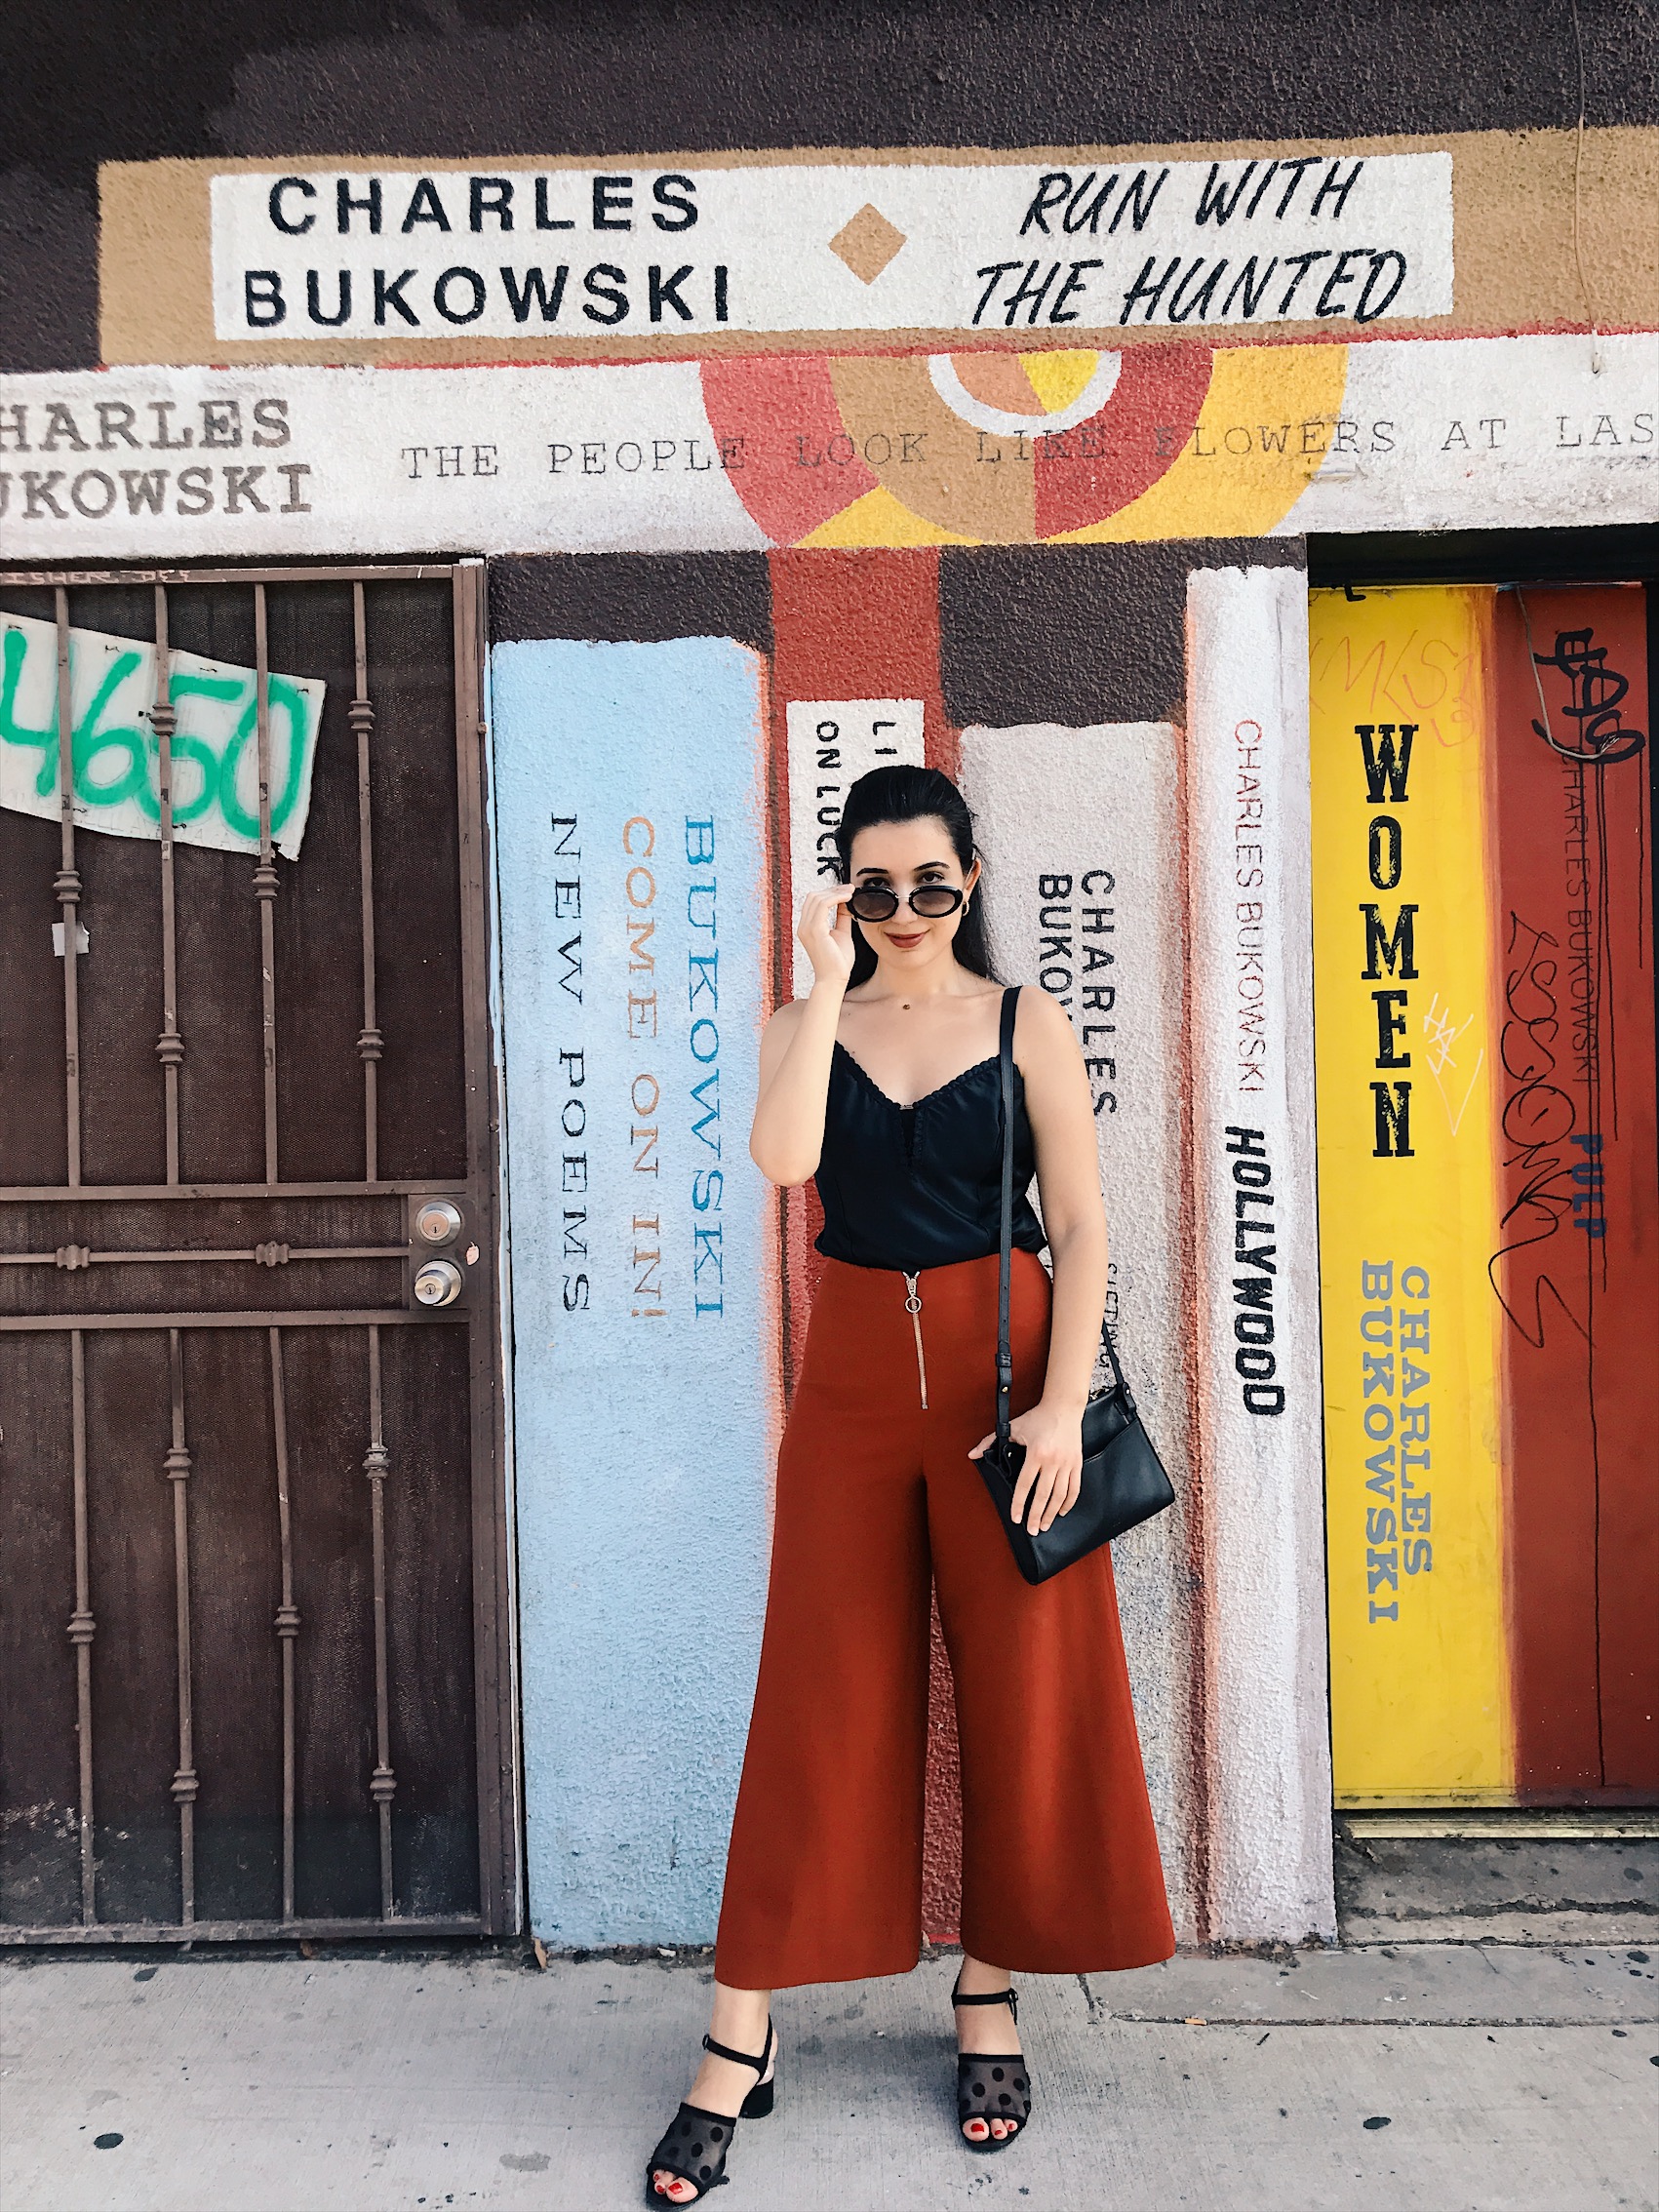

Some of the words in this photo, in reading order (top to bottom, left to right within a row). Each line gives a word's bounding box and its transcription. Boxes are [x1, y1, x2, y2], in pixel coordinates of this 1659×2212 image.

[269, 174, 700, 235] CHARLES
[1019, 167, 1171, 238] RUN
[1195, 156, 1365, 227] WITH
[245, 263, 731, 328] BUKOWSKI
[971, 258, 1104, 329] THE
[1120, 247, 1407, 325] HUNTED
[0, 398, 292, 453] HARLES
[401, 444, 500, 480] THE
[547, 436, 747, 475] PEOPLE
[795, 431, 930, 468] LOOK
[975, 424, 1106, 463] LIKE
[1154, 418, 1398, 460] FLOWERS
[1441, 417, 1507, 452] AT
[1556, 412, 1655, 448] LAS
[0, 629, 308, 842] 4650
[815, 720, 843, 770] ON
[1234, 719, 1264, 888] CHARLES
[551, 811, 583, 1006] NEW
[816, 785, 844, 884] LUCK
[622, 814, 658, 1040] COME
[1039, 874, 1073, 1022] BUKO
[1081, 869, 1118, 1117] CHARLES
[1236, 902, 1266, 1091] BUKOWSKI
[1354, 723, 1419, 1159] WOMEN
[1567, 910, 1599, 1084] BUKOWSKI
[629, 1073, 661, 1180] ON
[683, 813, 724, 1321] BUKOWSKI
[558, 1047, 591, 1313] POEMS
[1569, 1133, 1606, 1239] PULP
[630, 1214, 668, 1319] IN!
[1225, 1126, 1285, 1416] HOLLYWOOD
[1360, 1259, 1400, 1625] BUKOWSKI
[1399, 1266, 1434, 1576] CHARLES
